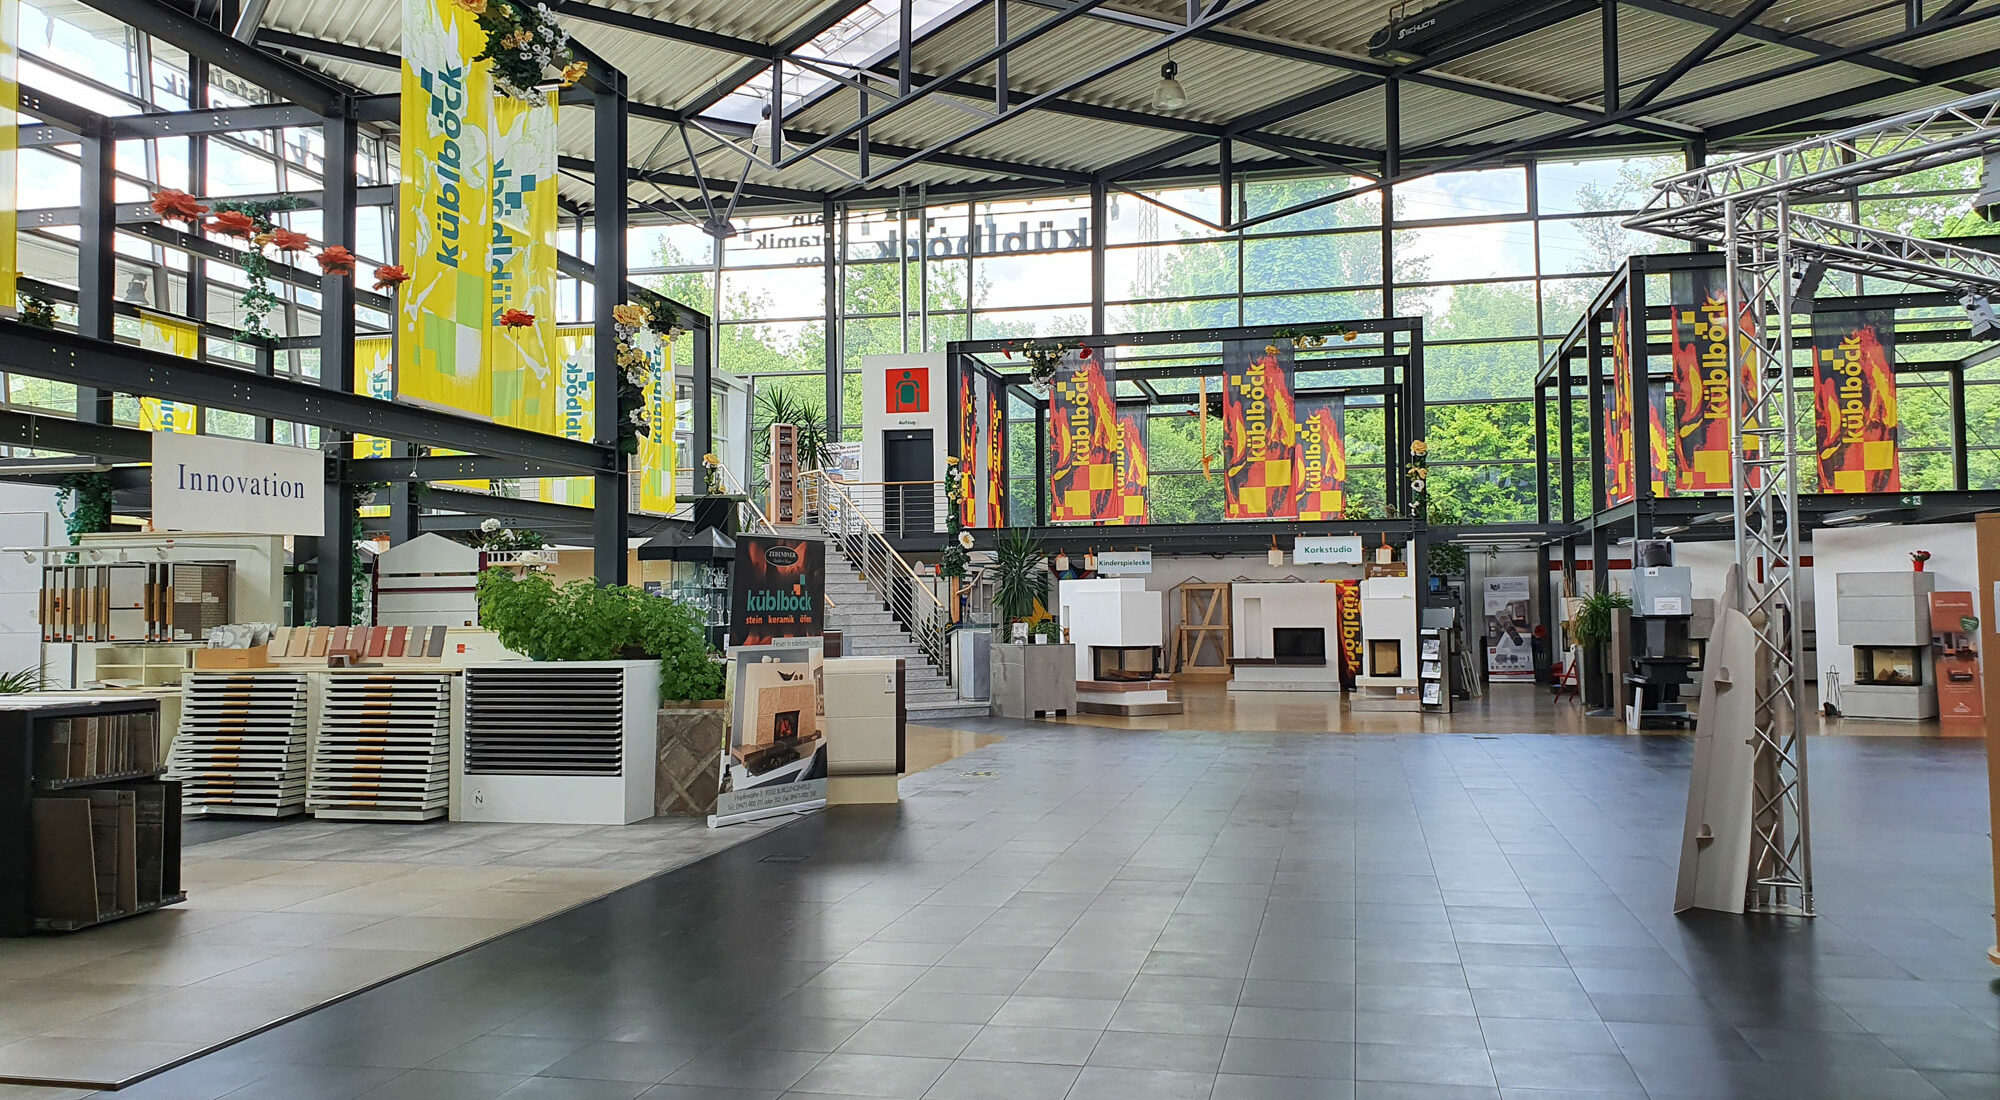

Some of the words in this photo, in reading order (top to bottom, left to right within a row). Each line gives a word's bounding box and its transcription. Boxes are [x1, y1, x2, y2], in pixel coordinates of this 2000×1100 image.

[436, 60, 463, 269] küblböck
[1701, 297, 1729, 419] küblböck
[1838, 336, 1864, 444] küblböck
[1070, 370, 1090, 467] küblböck
[1246, 362, 1266, 462] küblböck
[1305, 414, 1321, 492] küblböck
[177, 463, 305, 499] Innovation
[1304, 546, 1352, 554] Korkstudio
[745, 615, 763, 625] stein
[768, 615, 795, 624] keramik
[747, 589, 812, 612] küblböck
[1343, 585, 1360, 672] küblböck
